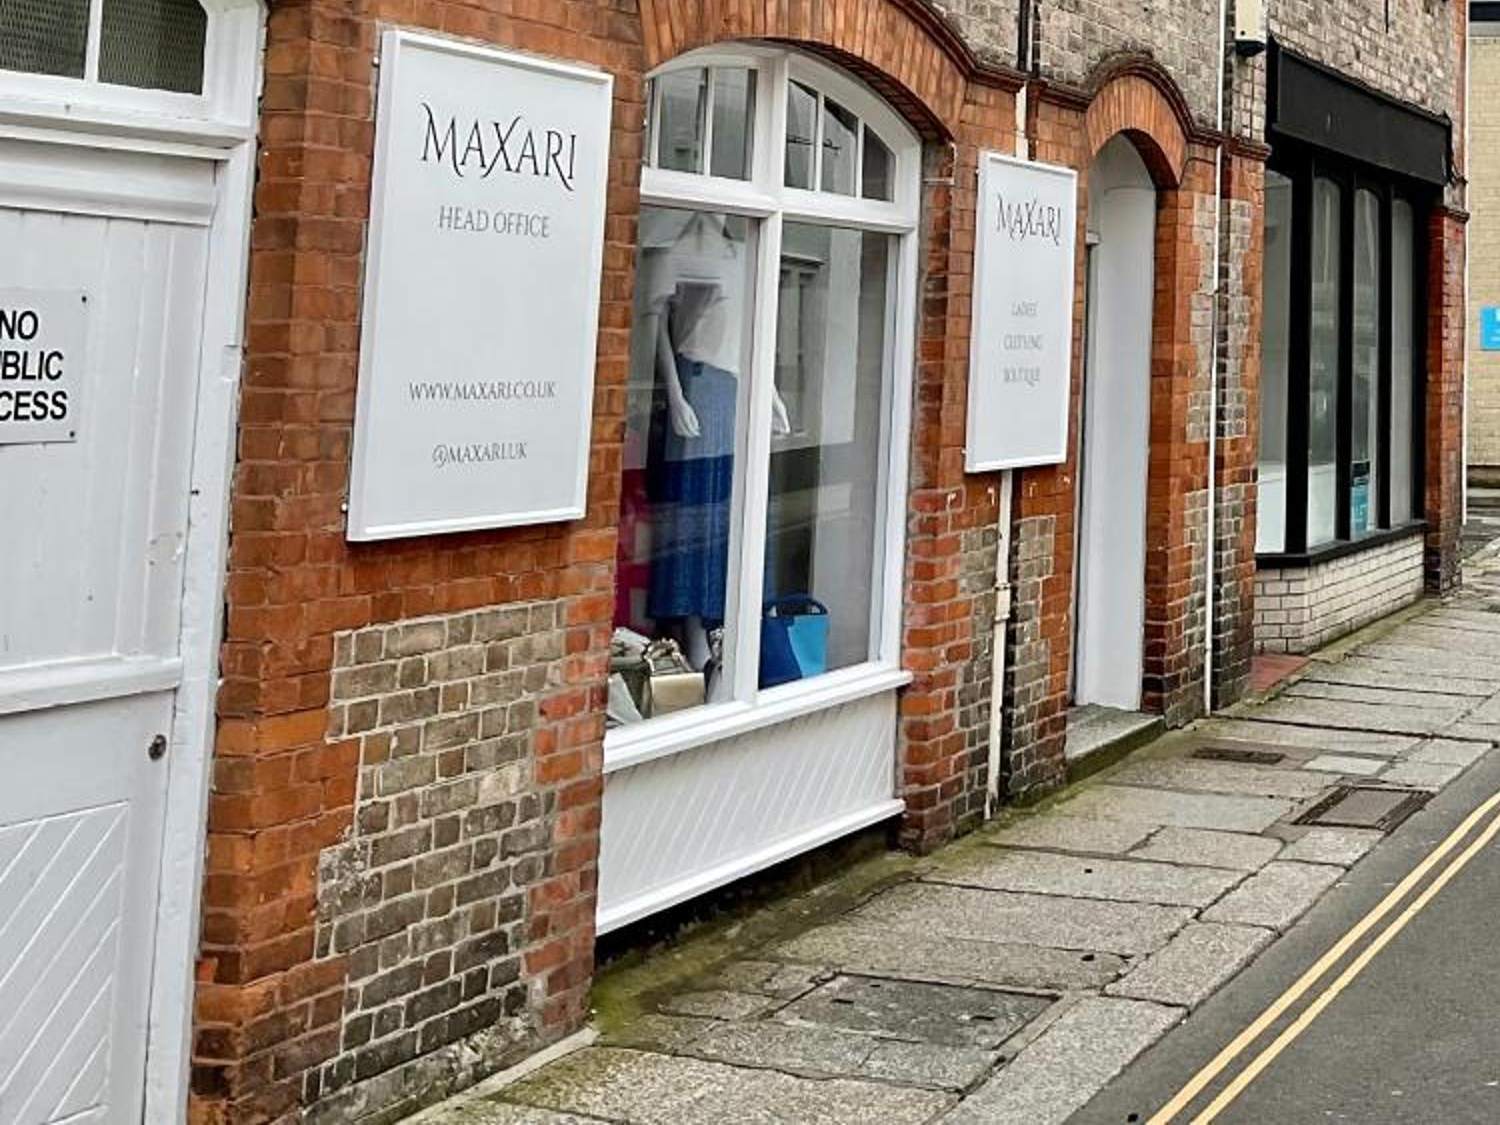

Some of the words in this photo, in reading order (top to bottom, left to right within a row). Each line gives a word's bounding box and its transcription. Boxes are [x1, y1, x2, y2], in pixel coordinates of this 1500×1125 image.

[420, 102, 577, 192] MAXARI
[438, 205, 489, 233] HEAD
[493, 210, 550, 238] OFFICE
[996, 194, 1061, 246] MAXARI
[0, 310, 39, 341] NO
[0, 350, 63, 381] BLIC
[408, 380, 556, 401] WWW.MAXARI.CO.UK
